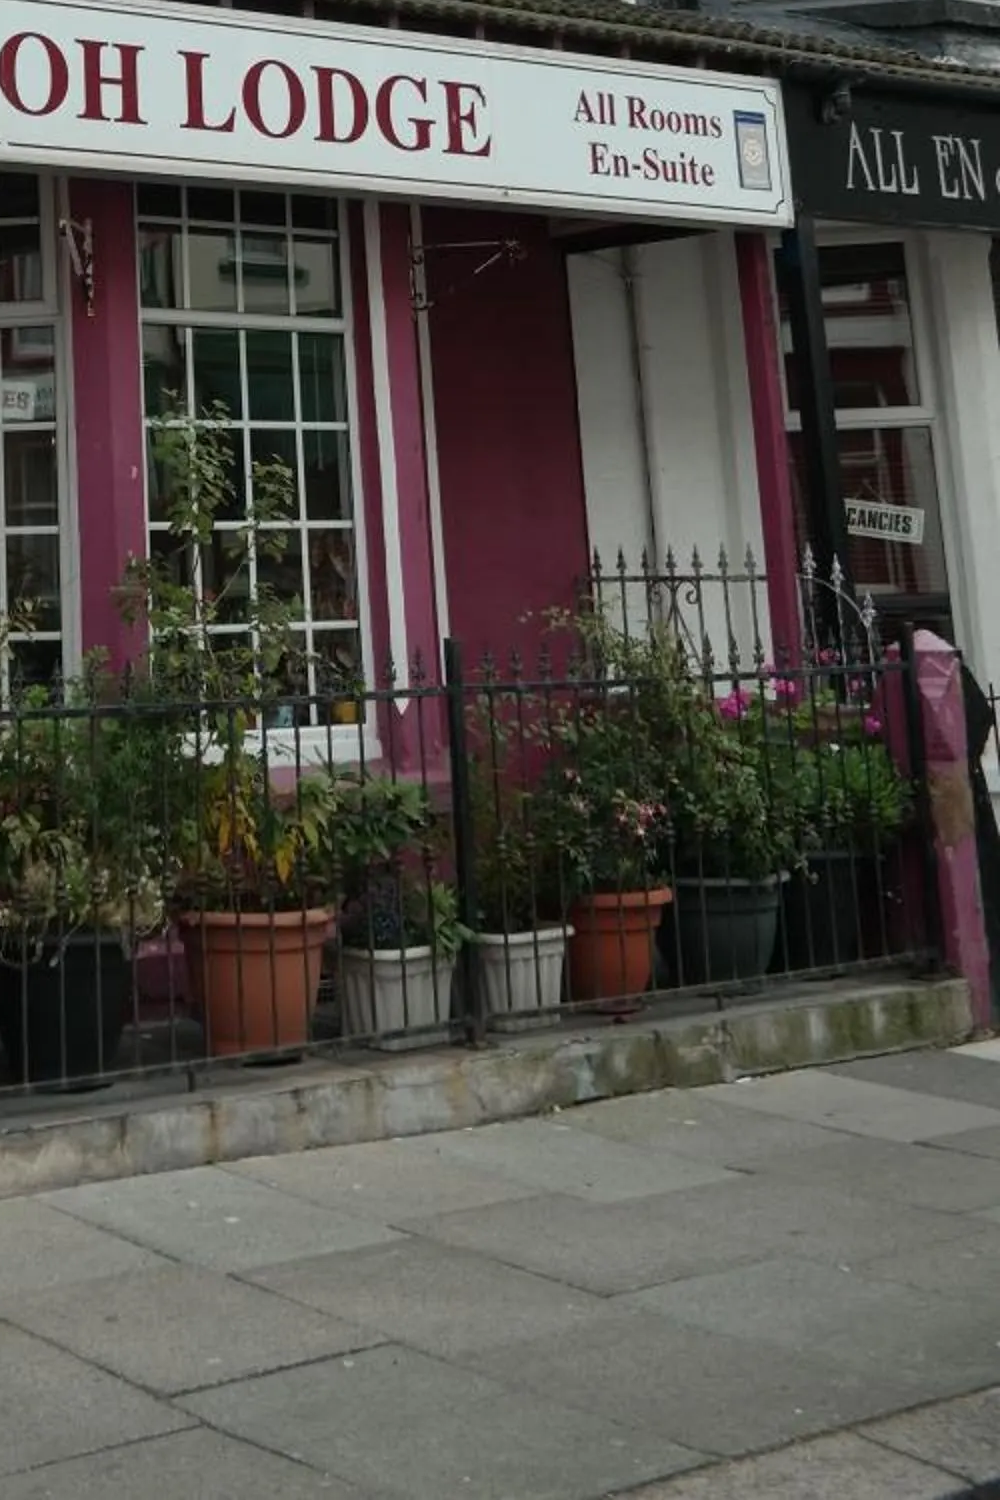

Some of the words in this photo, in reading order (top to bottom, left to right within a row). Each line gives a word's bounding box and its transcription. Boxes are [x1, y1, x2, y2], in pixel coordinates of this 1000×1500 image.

[177, 49, 492, 158] LODGE
[574, 88, 617, 127] All
[624, 95, 723, 139] Rooms
[588, 141, 716, 188] En-Suite
[846, 120, 921, 195] ALL
[931, 134, 986, 202] EN
[846, 507, 913, 535] CANCIES
